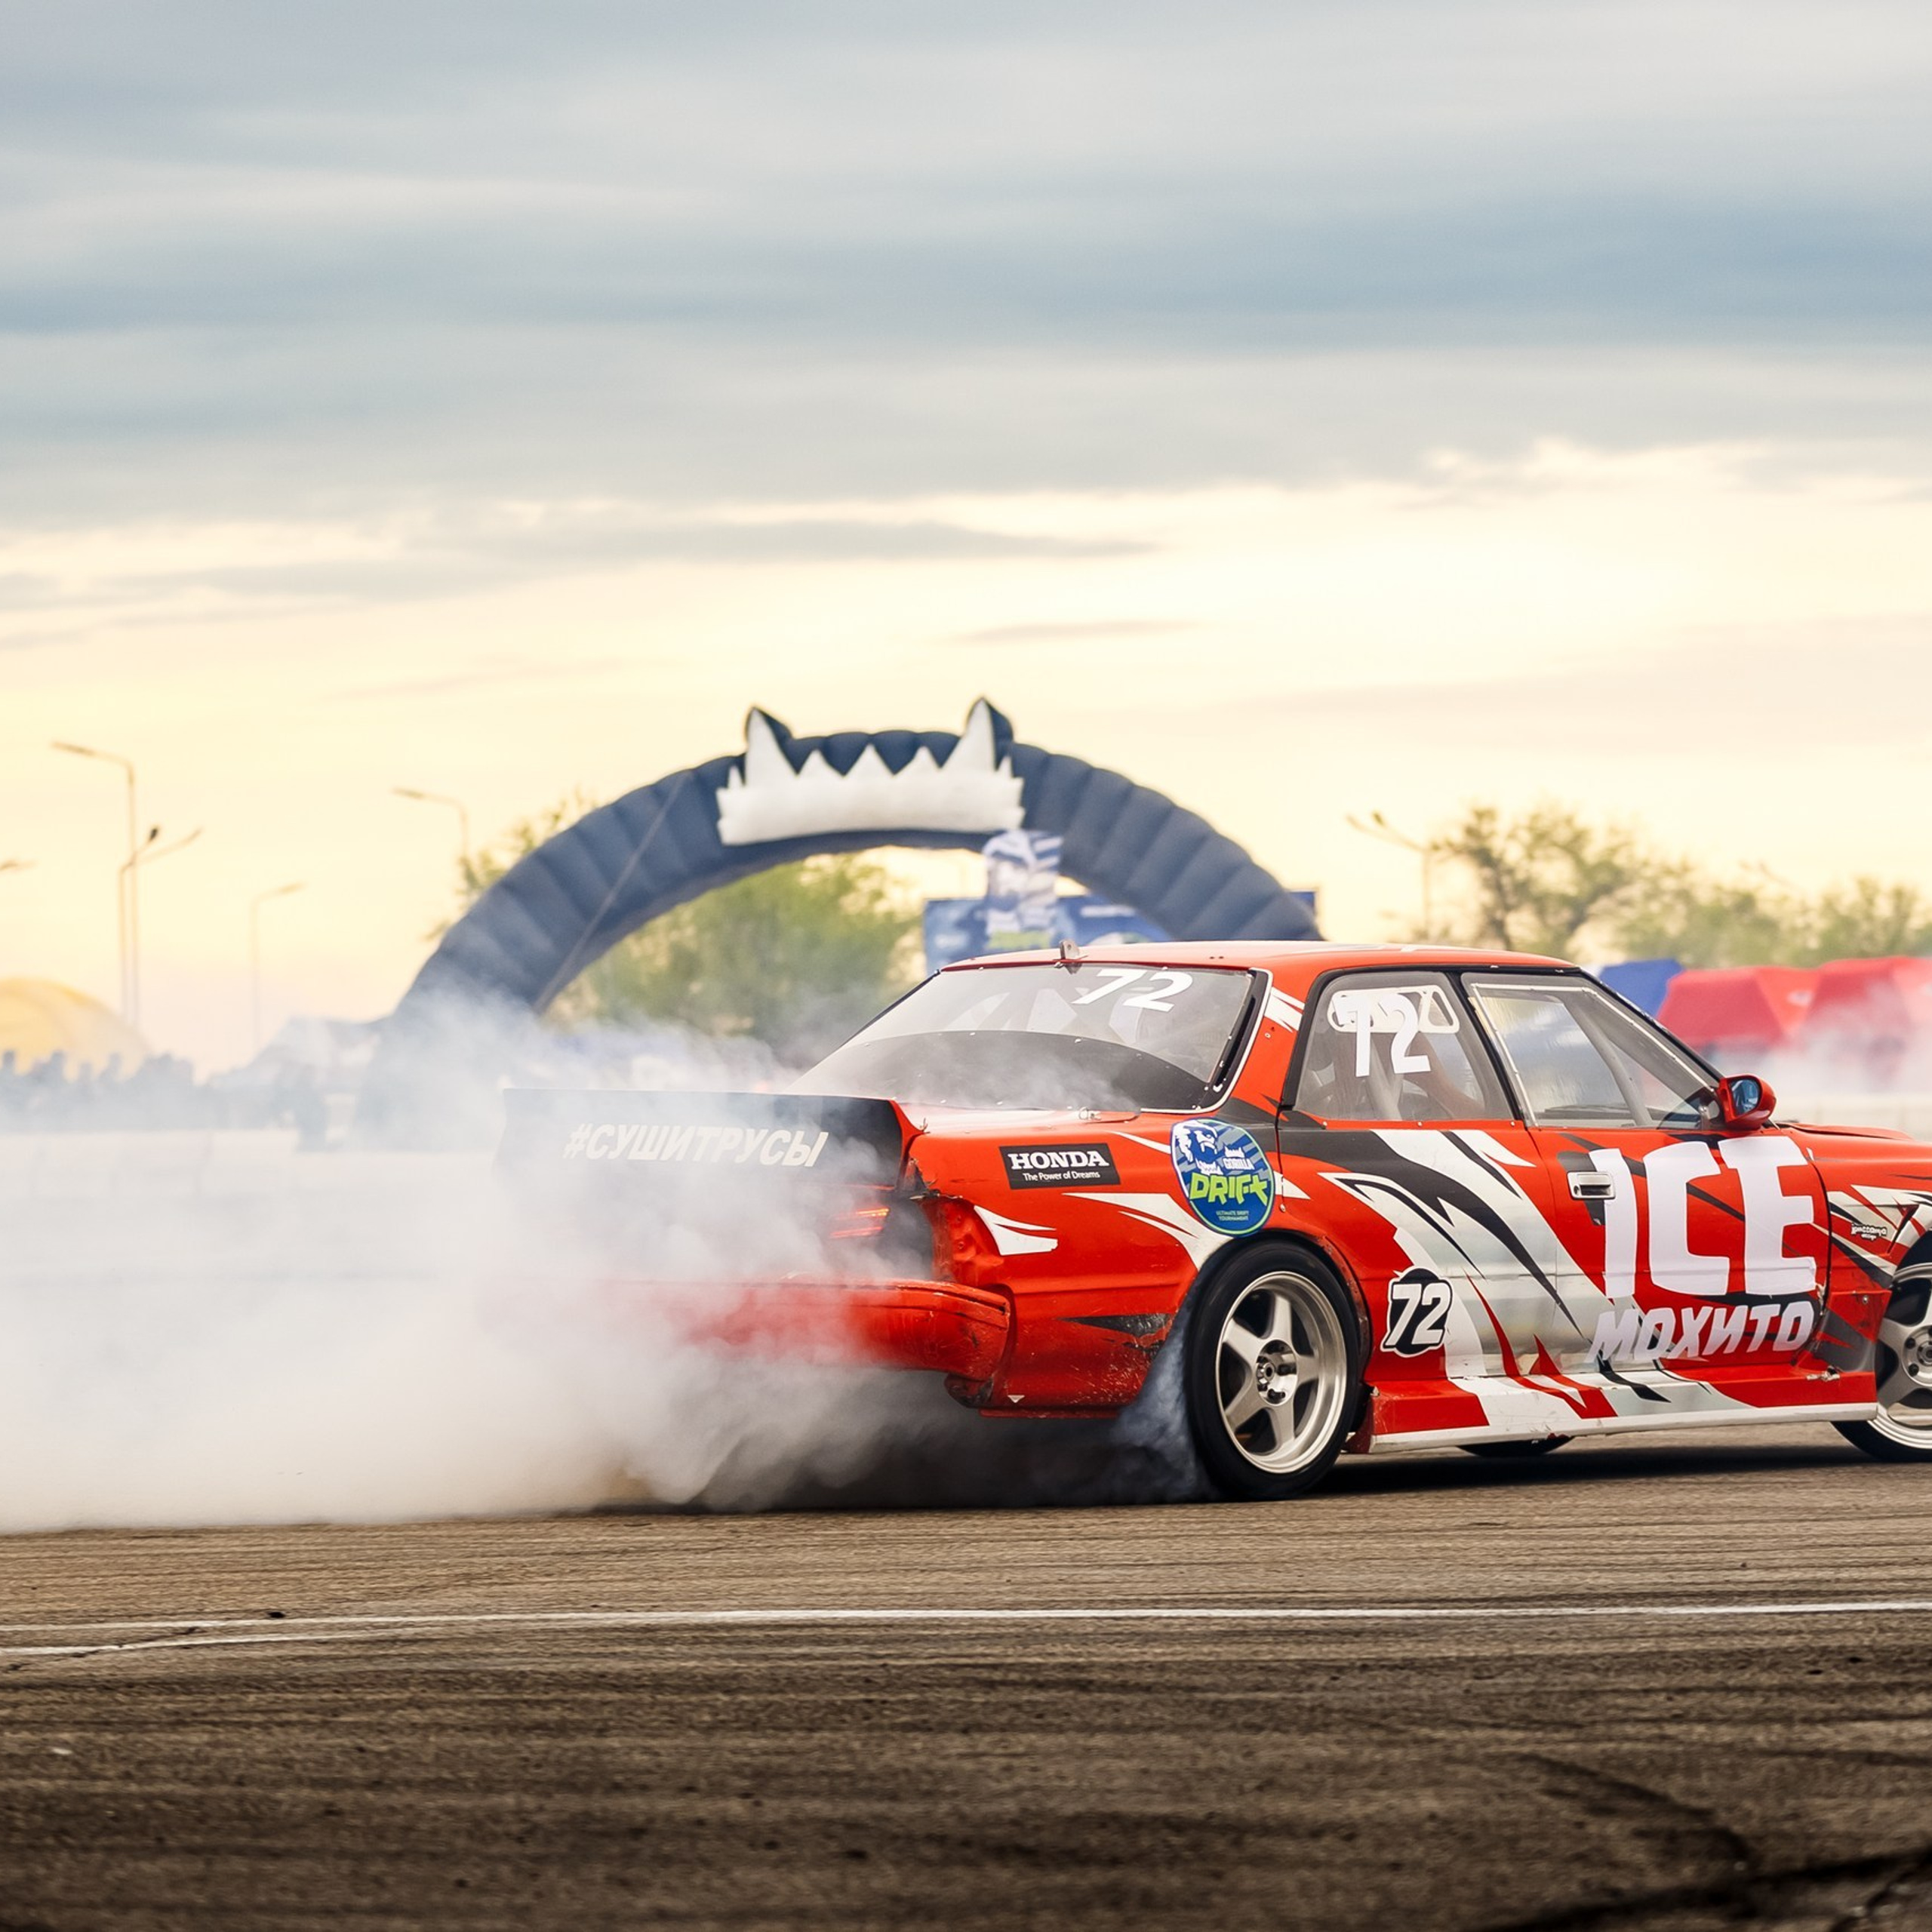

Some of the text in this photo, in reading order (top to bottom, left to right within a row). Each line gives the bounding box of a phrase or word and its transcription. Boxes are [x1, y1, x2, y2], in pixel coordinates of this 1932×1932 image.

[1072, 968, 1194, 1013] 72
[1331, 992, 1431, 1077] 72
[562, 1122, 829, 1168] #СУШИТРУСЫ
[1007, 1150, 1109, 1170] HONDA
[1023, 1171, 1100, 1182] The Power of Dreams
[1189, 1172, 1268, 1207] DRIFT
[1589, 1135, 1817, 1298] ICE
[1384, 1283, 1451, 1346] 72
[1584, 1300, 1815, 1361] МОХИТО
